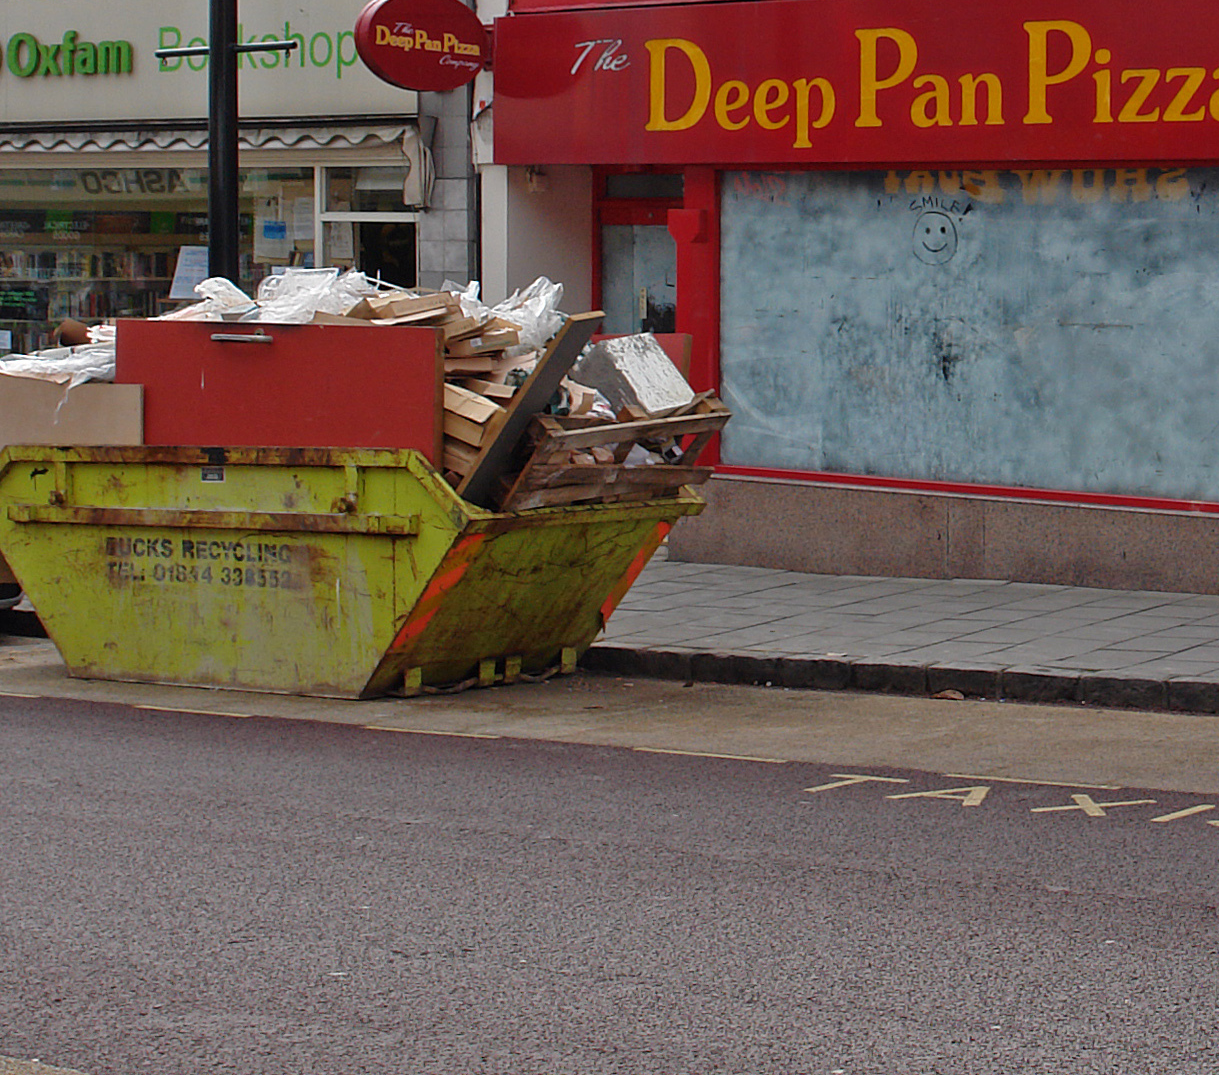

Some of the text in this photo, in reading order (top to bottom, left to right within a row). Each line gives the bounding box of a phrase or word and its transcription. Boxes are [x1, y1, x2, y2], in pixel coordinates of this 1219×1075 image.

[375, 25, 480, 56] Deep Pan Pizza
[393, 22, 414, 34] The
[6, 21, 358, 79] Oxfam Bokshop
[439, 54, 480, 71] Company
[569, 38, 631, 76] The
[644, 38, 836, 149] Deep
[854, 27, 1005, 128] Pan
[182, 539, 293, 564] RECYCLING
